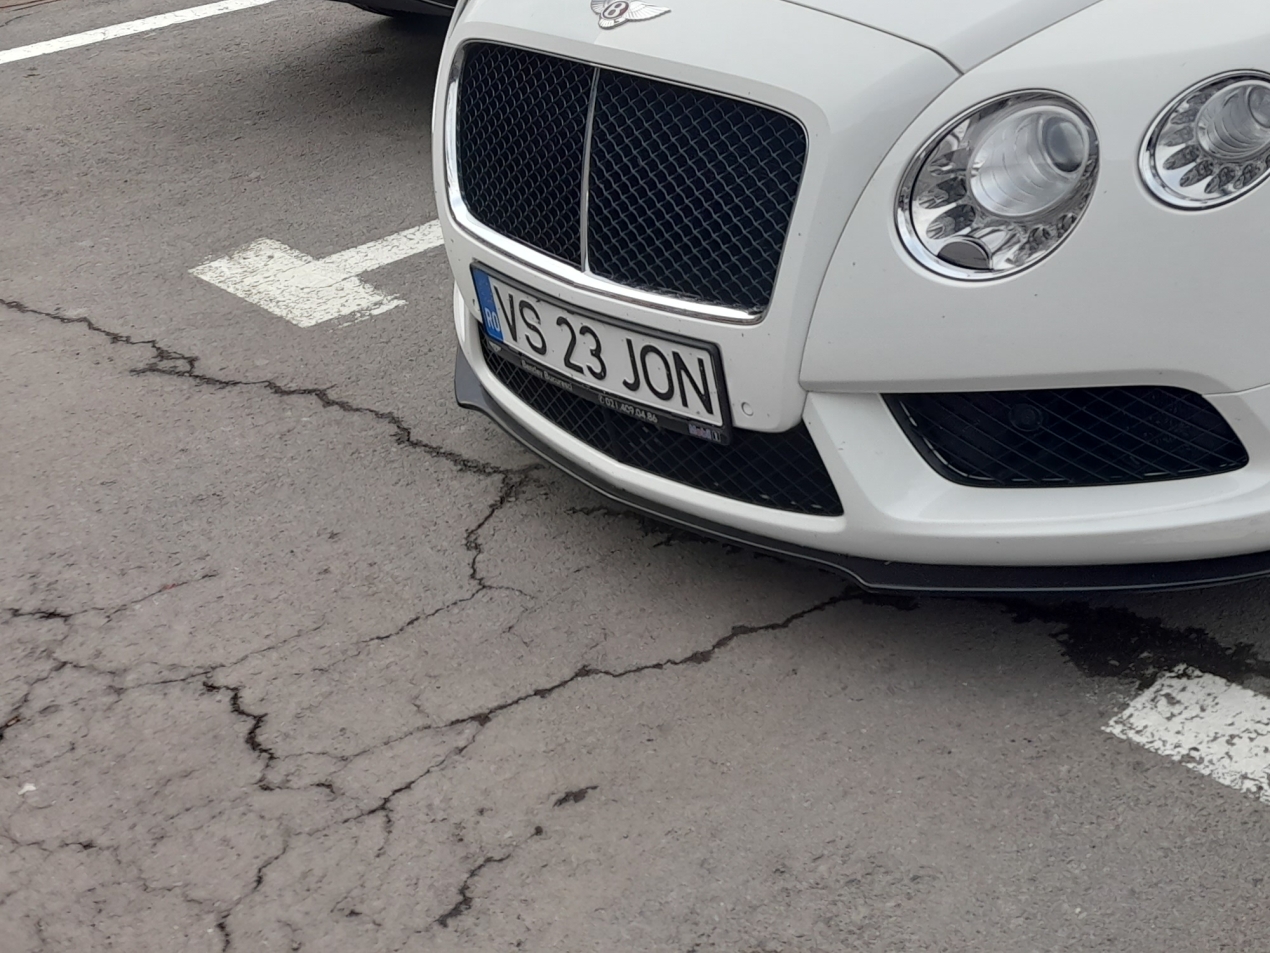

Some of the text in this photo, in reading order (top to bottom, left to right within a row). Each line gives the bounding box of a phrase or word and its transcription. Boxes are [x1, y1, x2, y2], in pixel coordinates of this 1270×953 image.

[485, 308, 500, 331] RO
[494, 285, 714, 416] VS 23 JON
